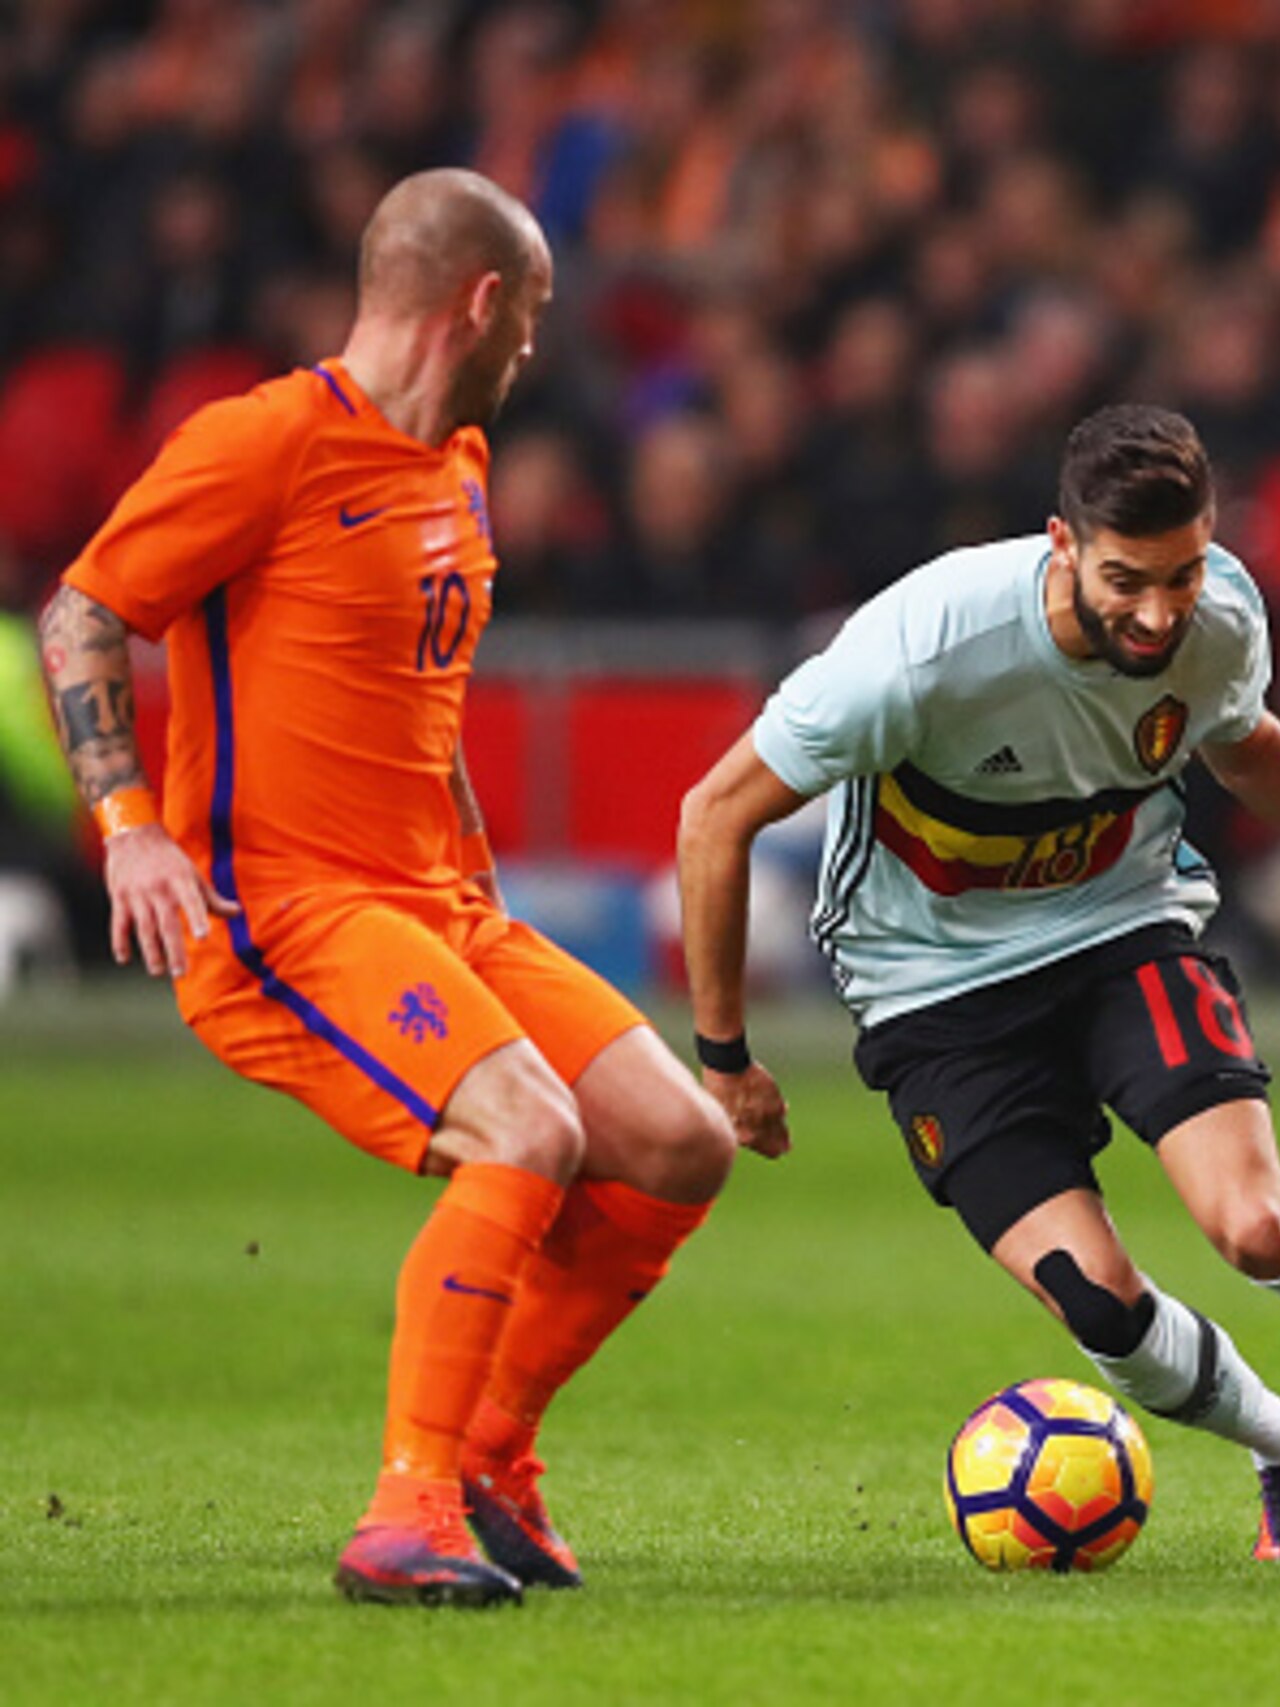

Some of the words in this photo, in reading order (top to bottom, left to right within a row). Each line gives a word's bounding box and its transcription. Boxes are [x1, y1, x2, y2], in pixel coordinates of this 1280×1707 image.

[417, 572, 470, 671] 10
[1004, 815, 1092, 889] 18
[1136, 956, 1254, 1069] 18
